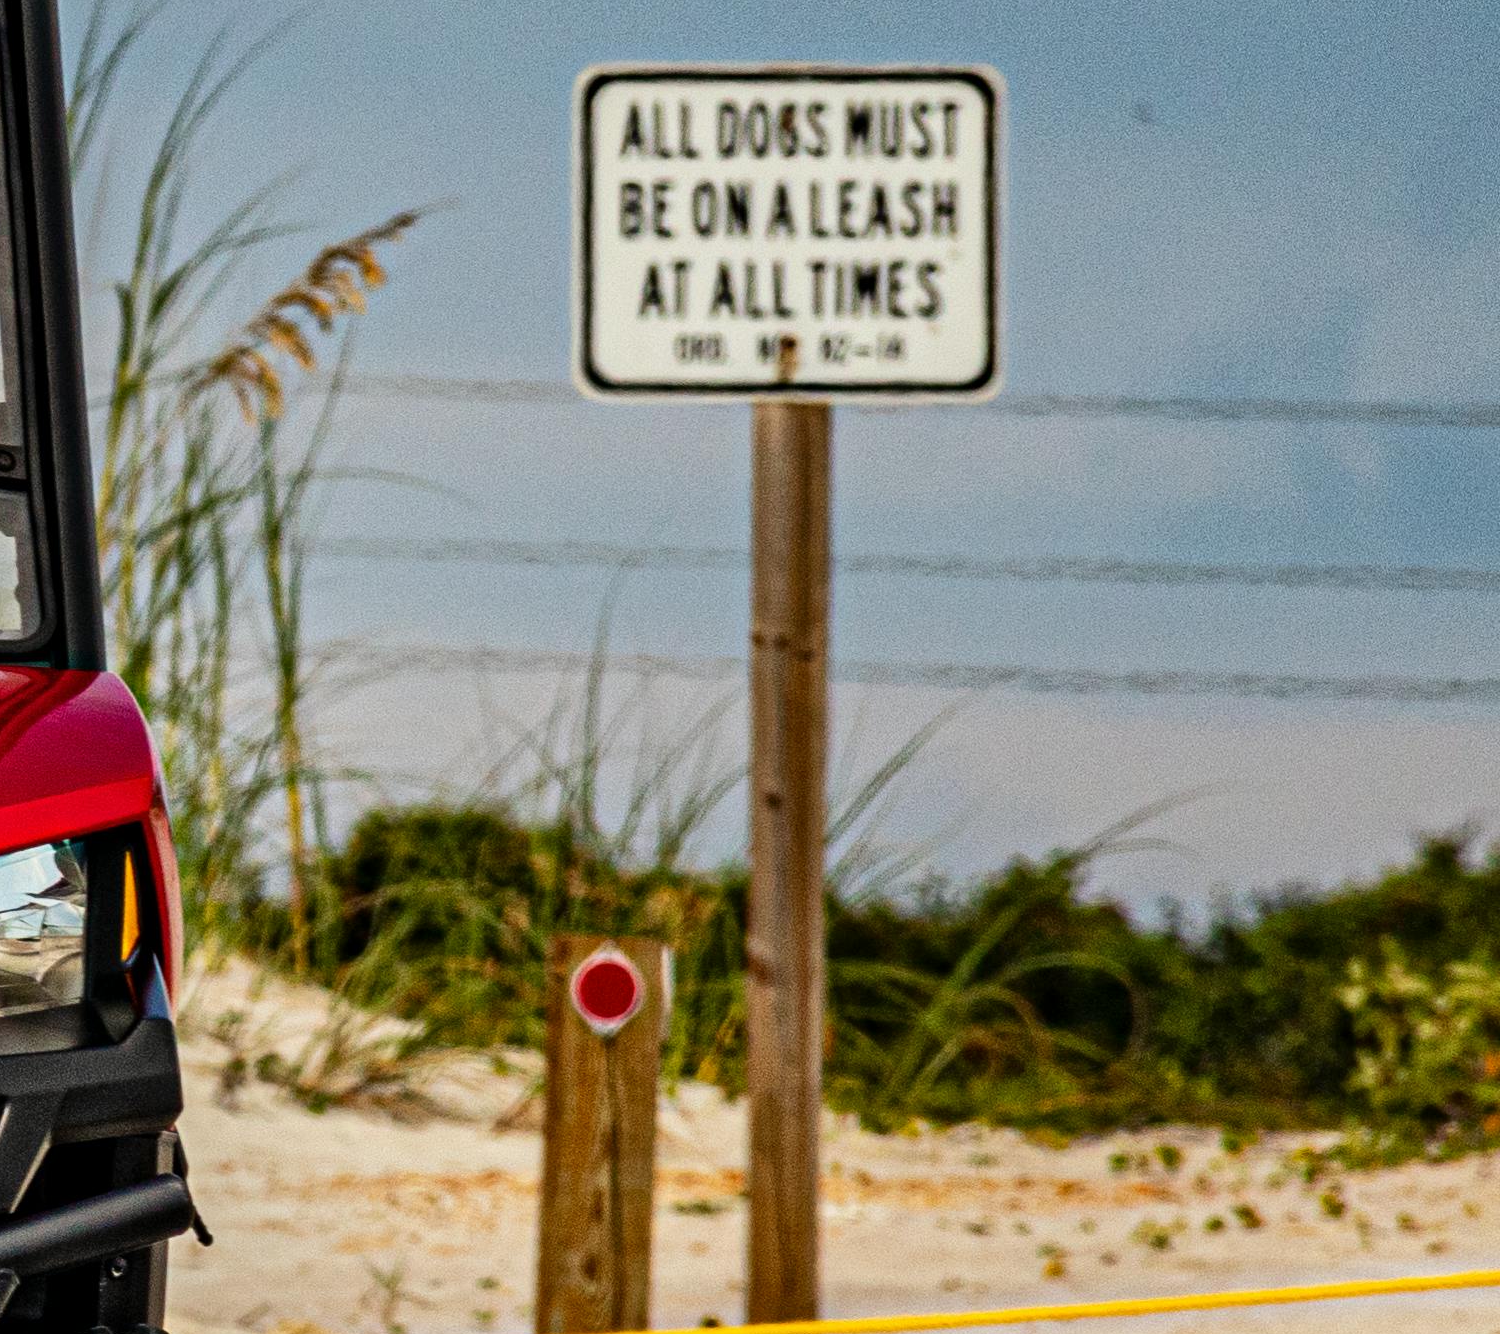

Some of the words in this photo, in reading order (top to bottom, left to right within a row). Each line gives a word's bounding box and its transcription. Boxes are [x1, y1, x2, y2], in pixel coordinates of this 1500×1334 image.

[619, 100, 699, 159] ALL
[717, 100, 830, 159] DOGS
[845, 99, 962, 159] MUST
[618, 180, 674, 240] BE
[691, 180, 752, 239] ON
[766, 180, 797, 240] A
[808, 179, 960, 239] LEASH
[638, 259, 692, 318] AT
[710, 259, 797, 319] ALL
[807, 259, 943, 319] TIMES
